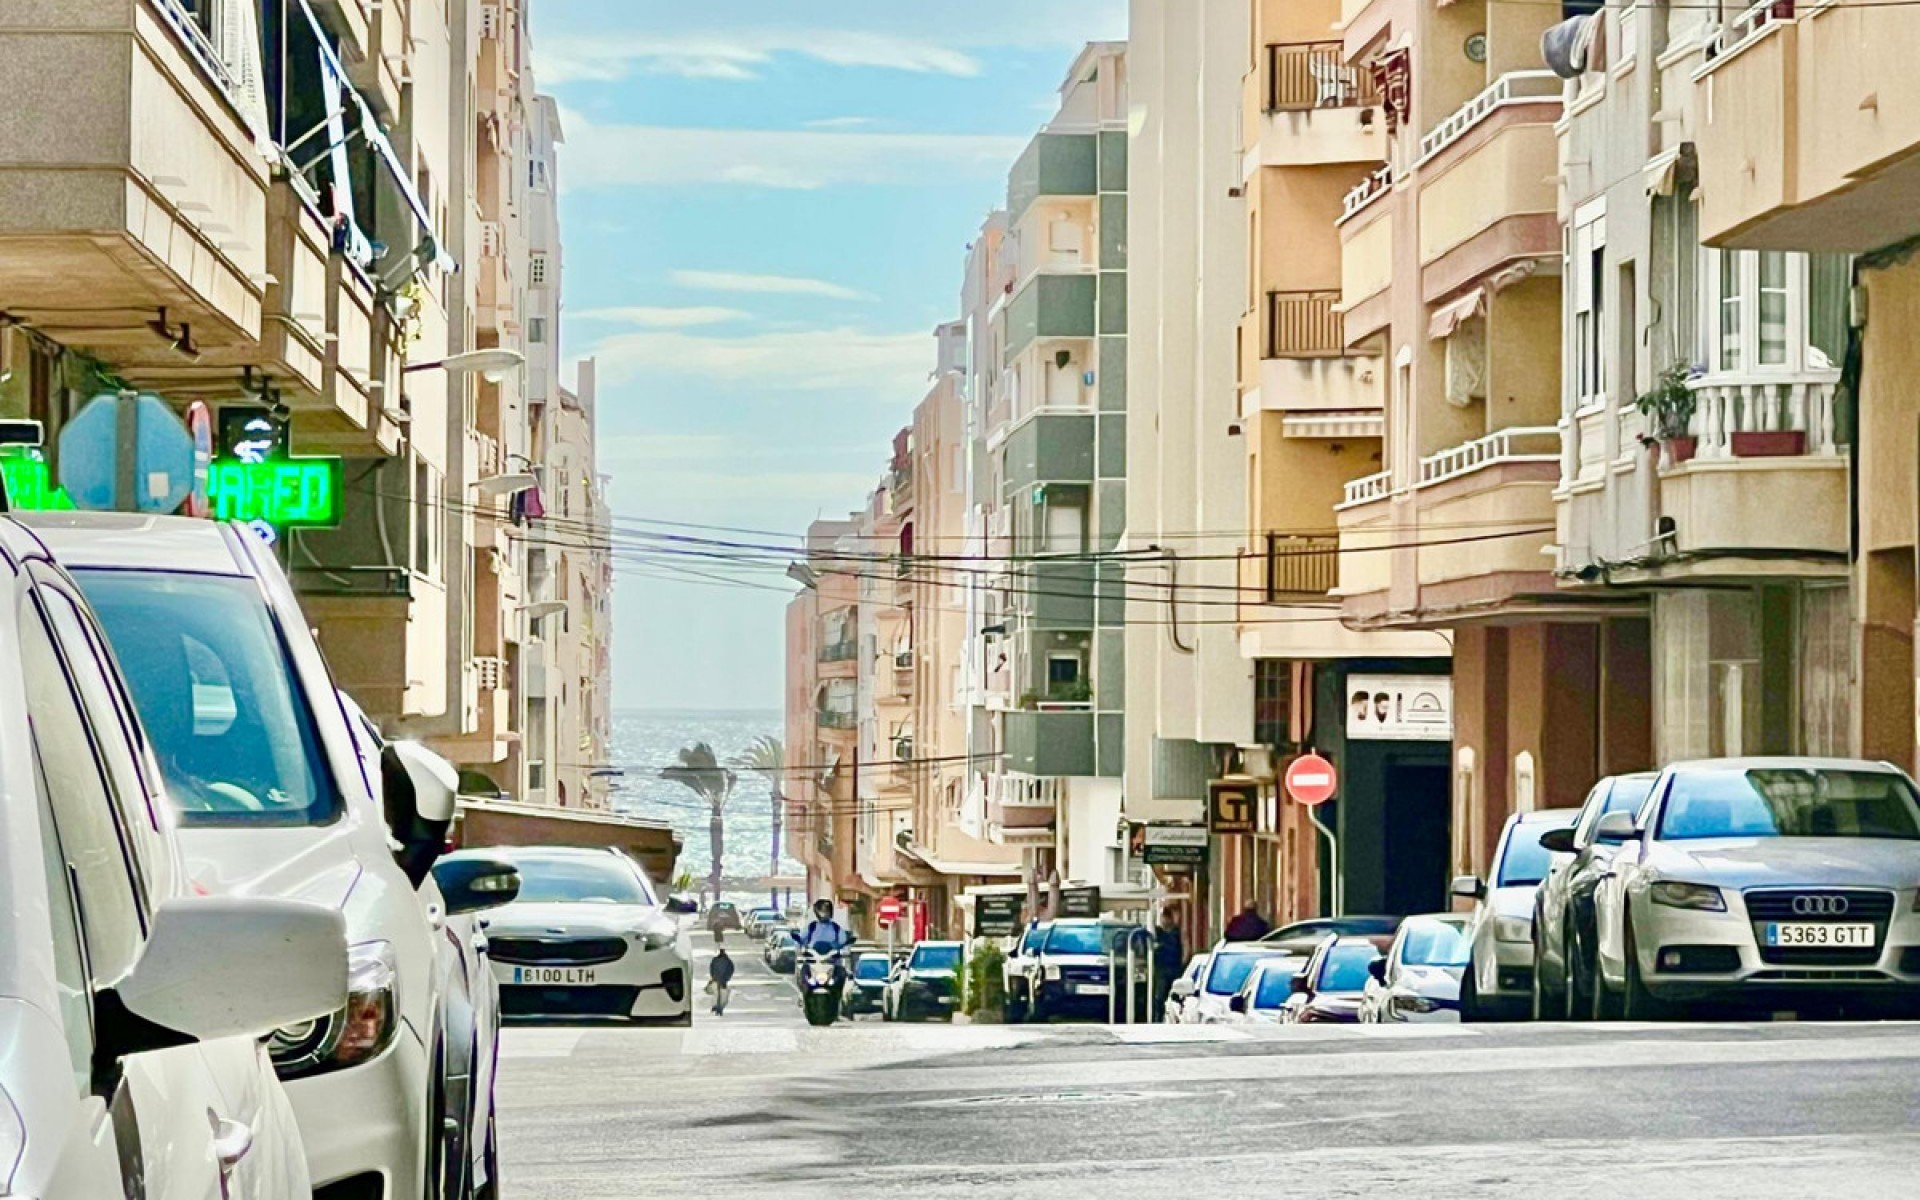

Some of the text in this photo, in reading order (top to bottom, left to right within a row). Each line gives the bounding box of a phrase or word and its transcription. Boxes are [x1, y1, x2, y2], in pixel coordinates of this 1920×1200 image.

[1782, 926, 1869, 943] 5363 GTT
[524, 968, 595, 983] 6100 LTH
